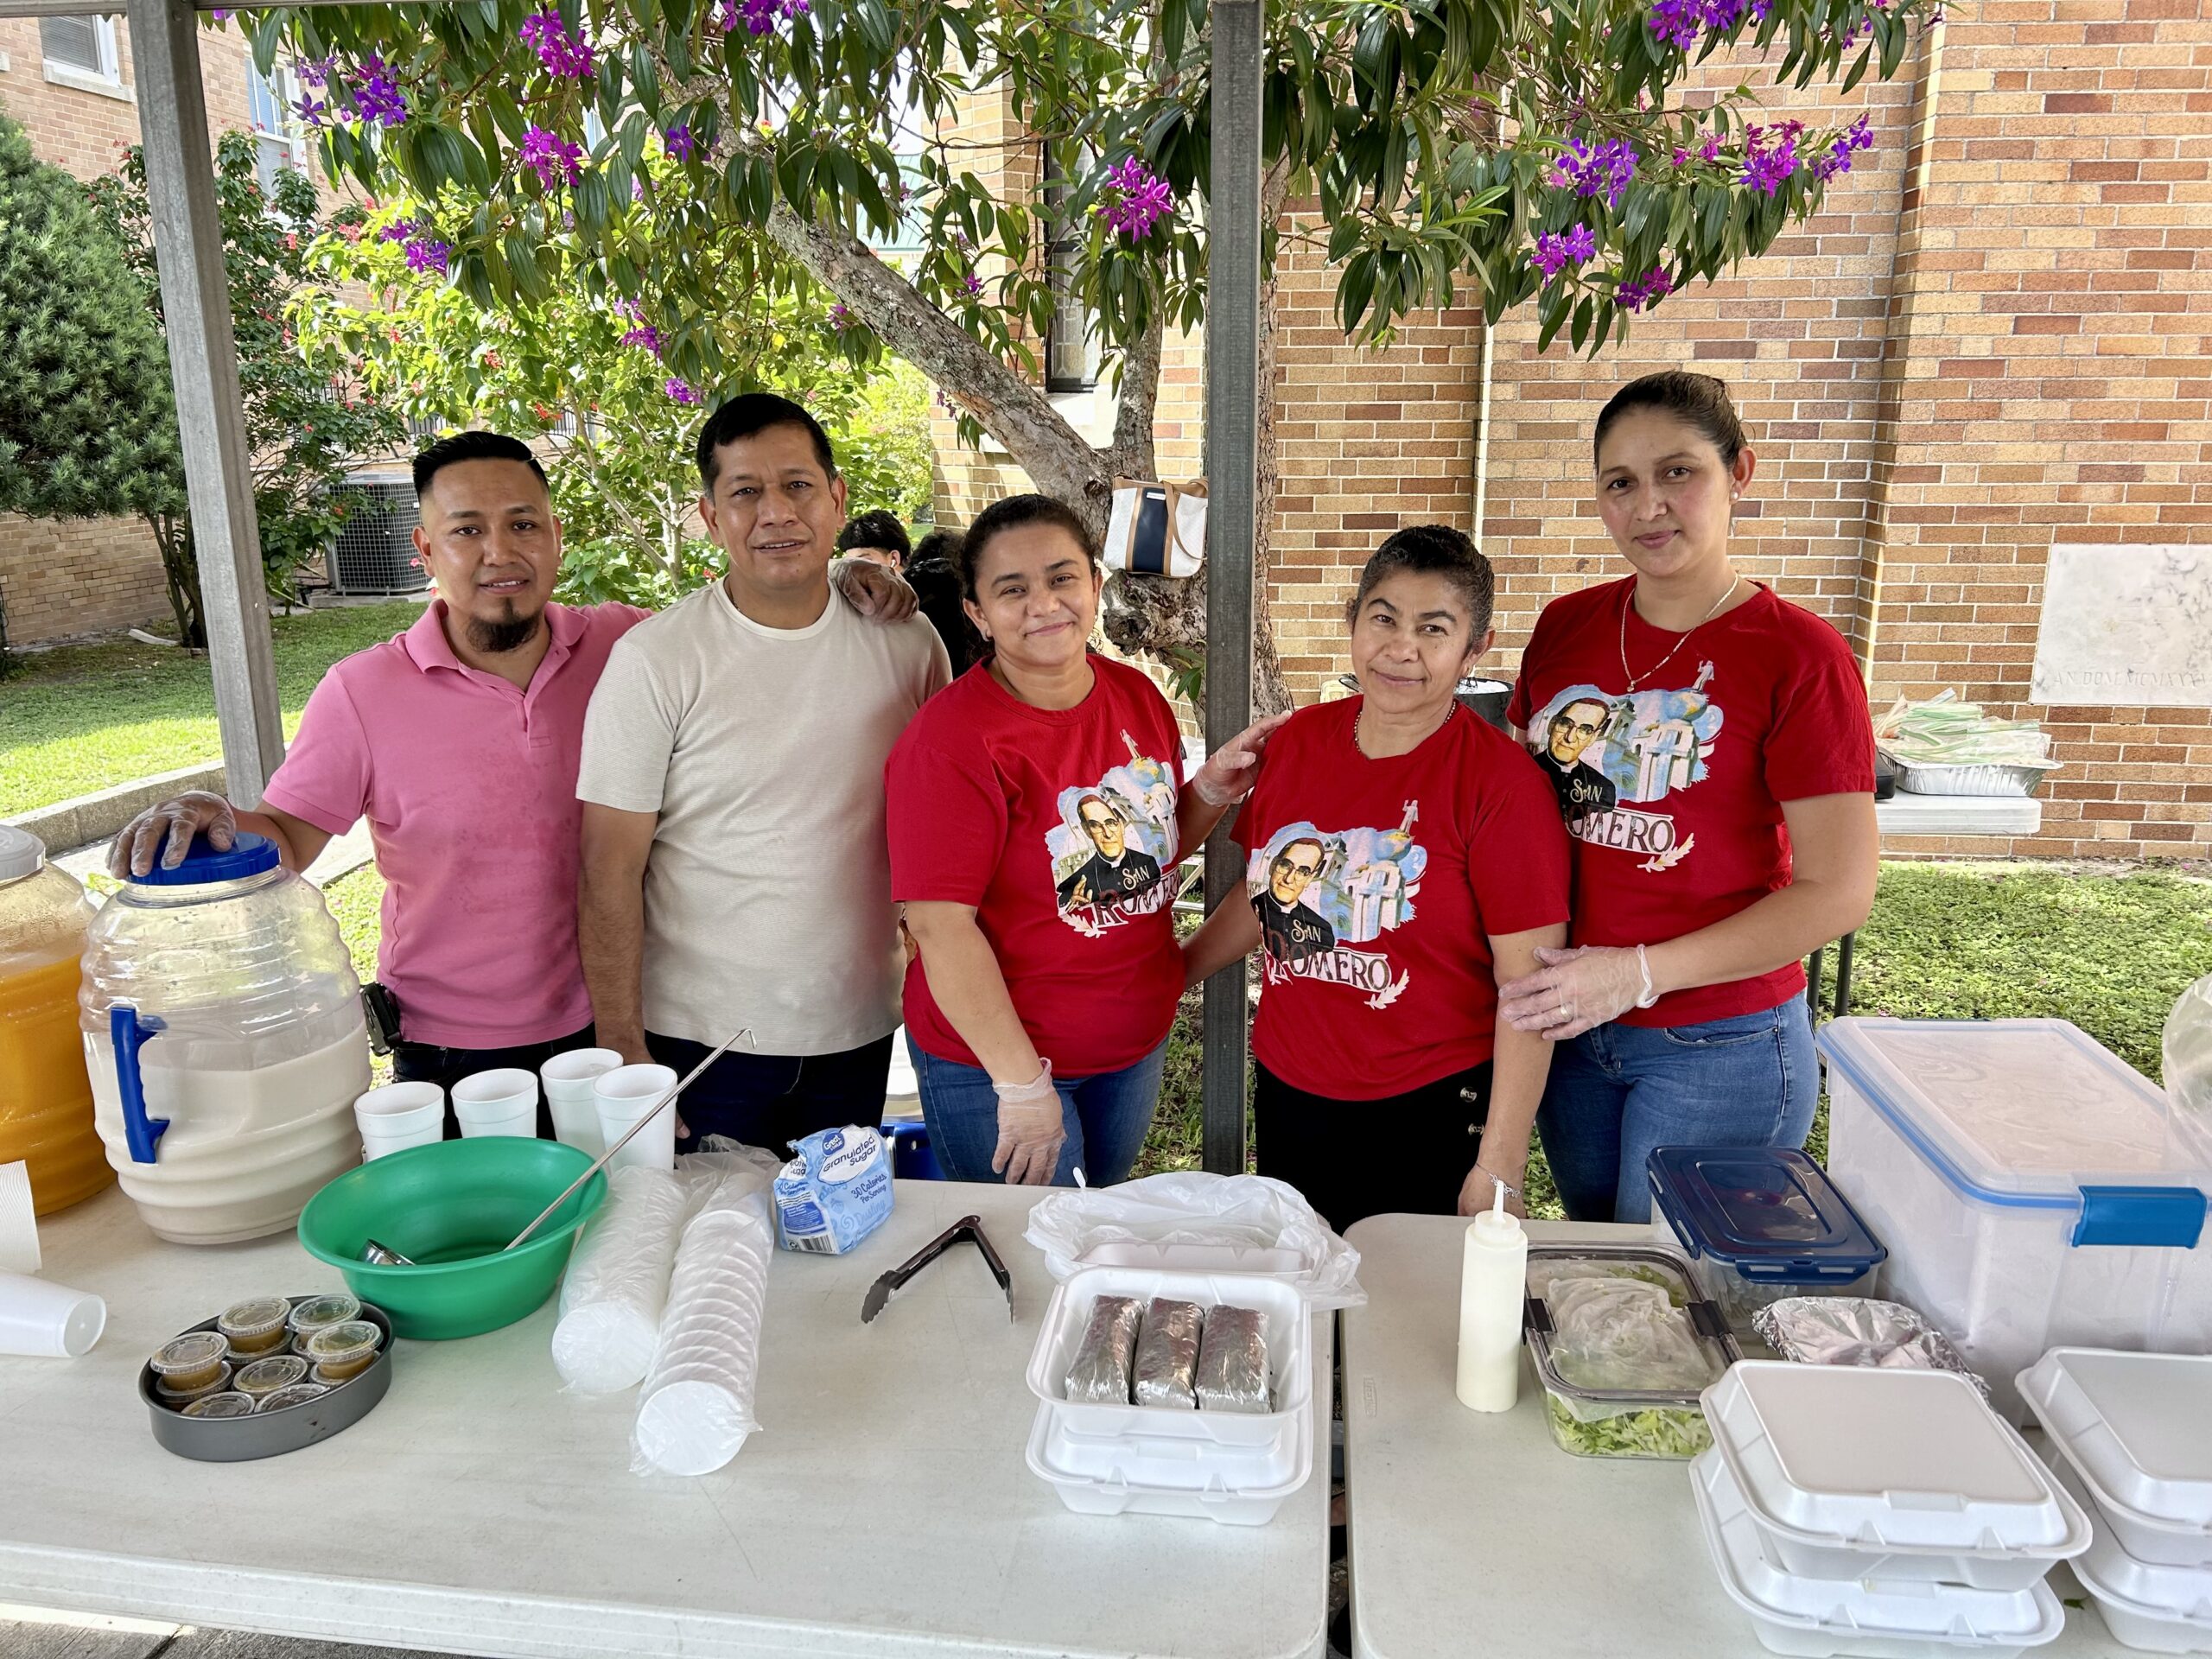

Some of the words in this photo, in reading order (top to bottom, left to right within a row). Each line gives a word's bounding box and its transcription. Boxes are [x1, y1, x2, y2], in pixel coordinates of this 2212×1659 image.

[1569, 779, 1603, 803] SAN
[1567, 804, 1674, 853] OMERO
[1122, 865, 1150, 890] SAN
[1291, 919, 1321, 943] SAN
[823, 1134, 875, 1173] Granulated
[850, 1186, 862, 1199] 30
[861, 1173, 887, 1192] Calories
[860, 1193, 870, 1204] Per
[868, 1184, 887, 1199] Serving
